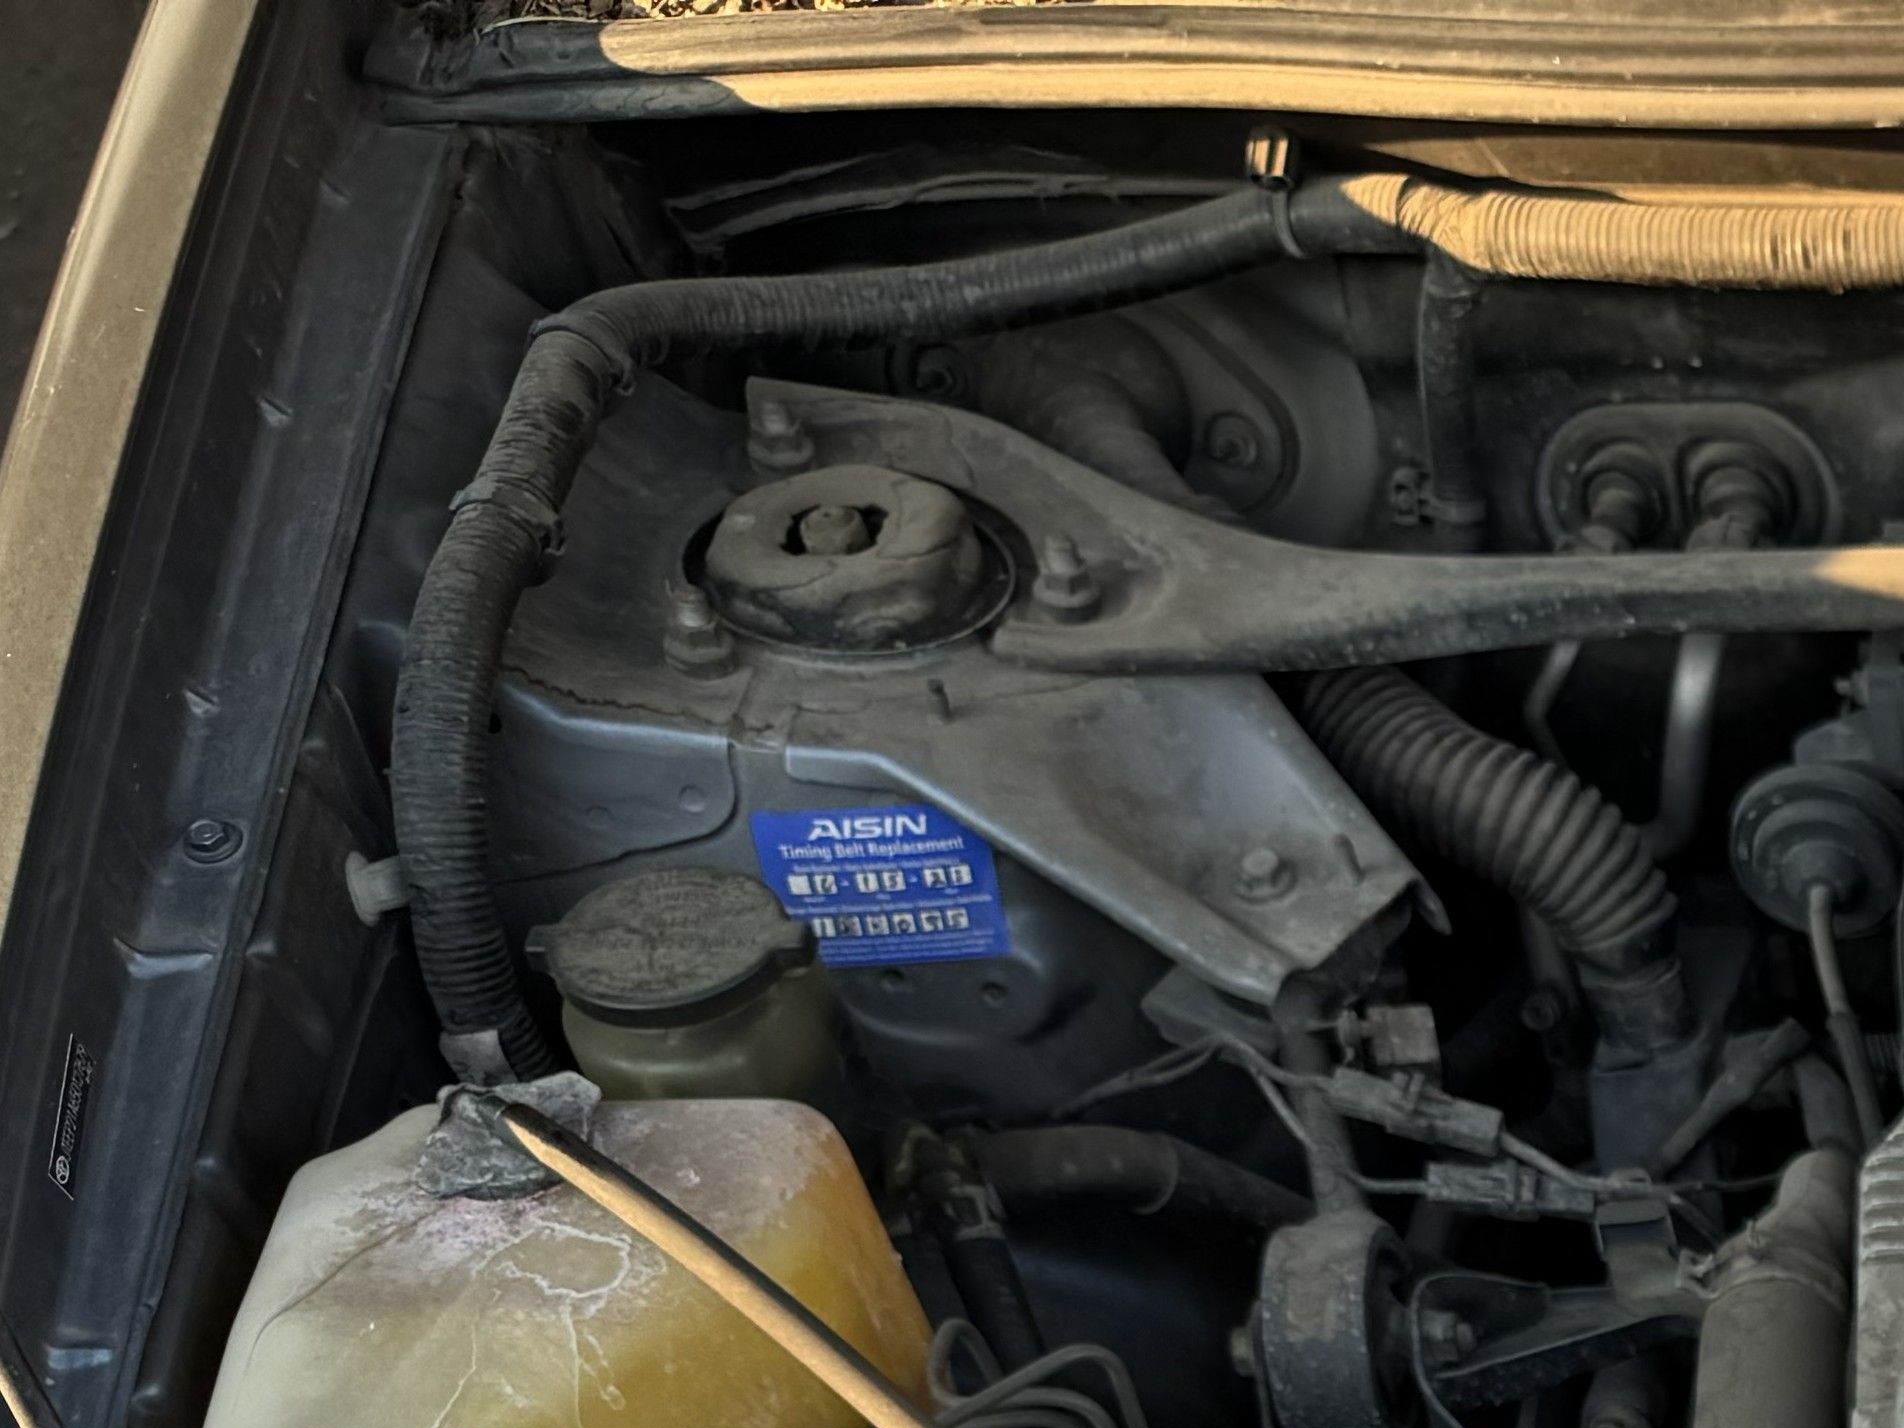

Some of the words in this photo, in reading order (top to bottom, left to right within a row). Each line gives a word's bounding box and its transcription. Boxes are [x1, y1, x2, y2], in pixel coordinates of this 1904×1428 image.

[808, 814, 927, 841] AISIN
[779, 842, 832, 862] Timing
[834, 842, 865, 858] Belt
[867, 836, 963, 858] Replacement
